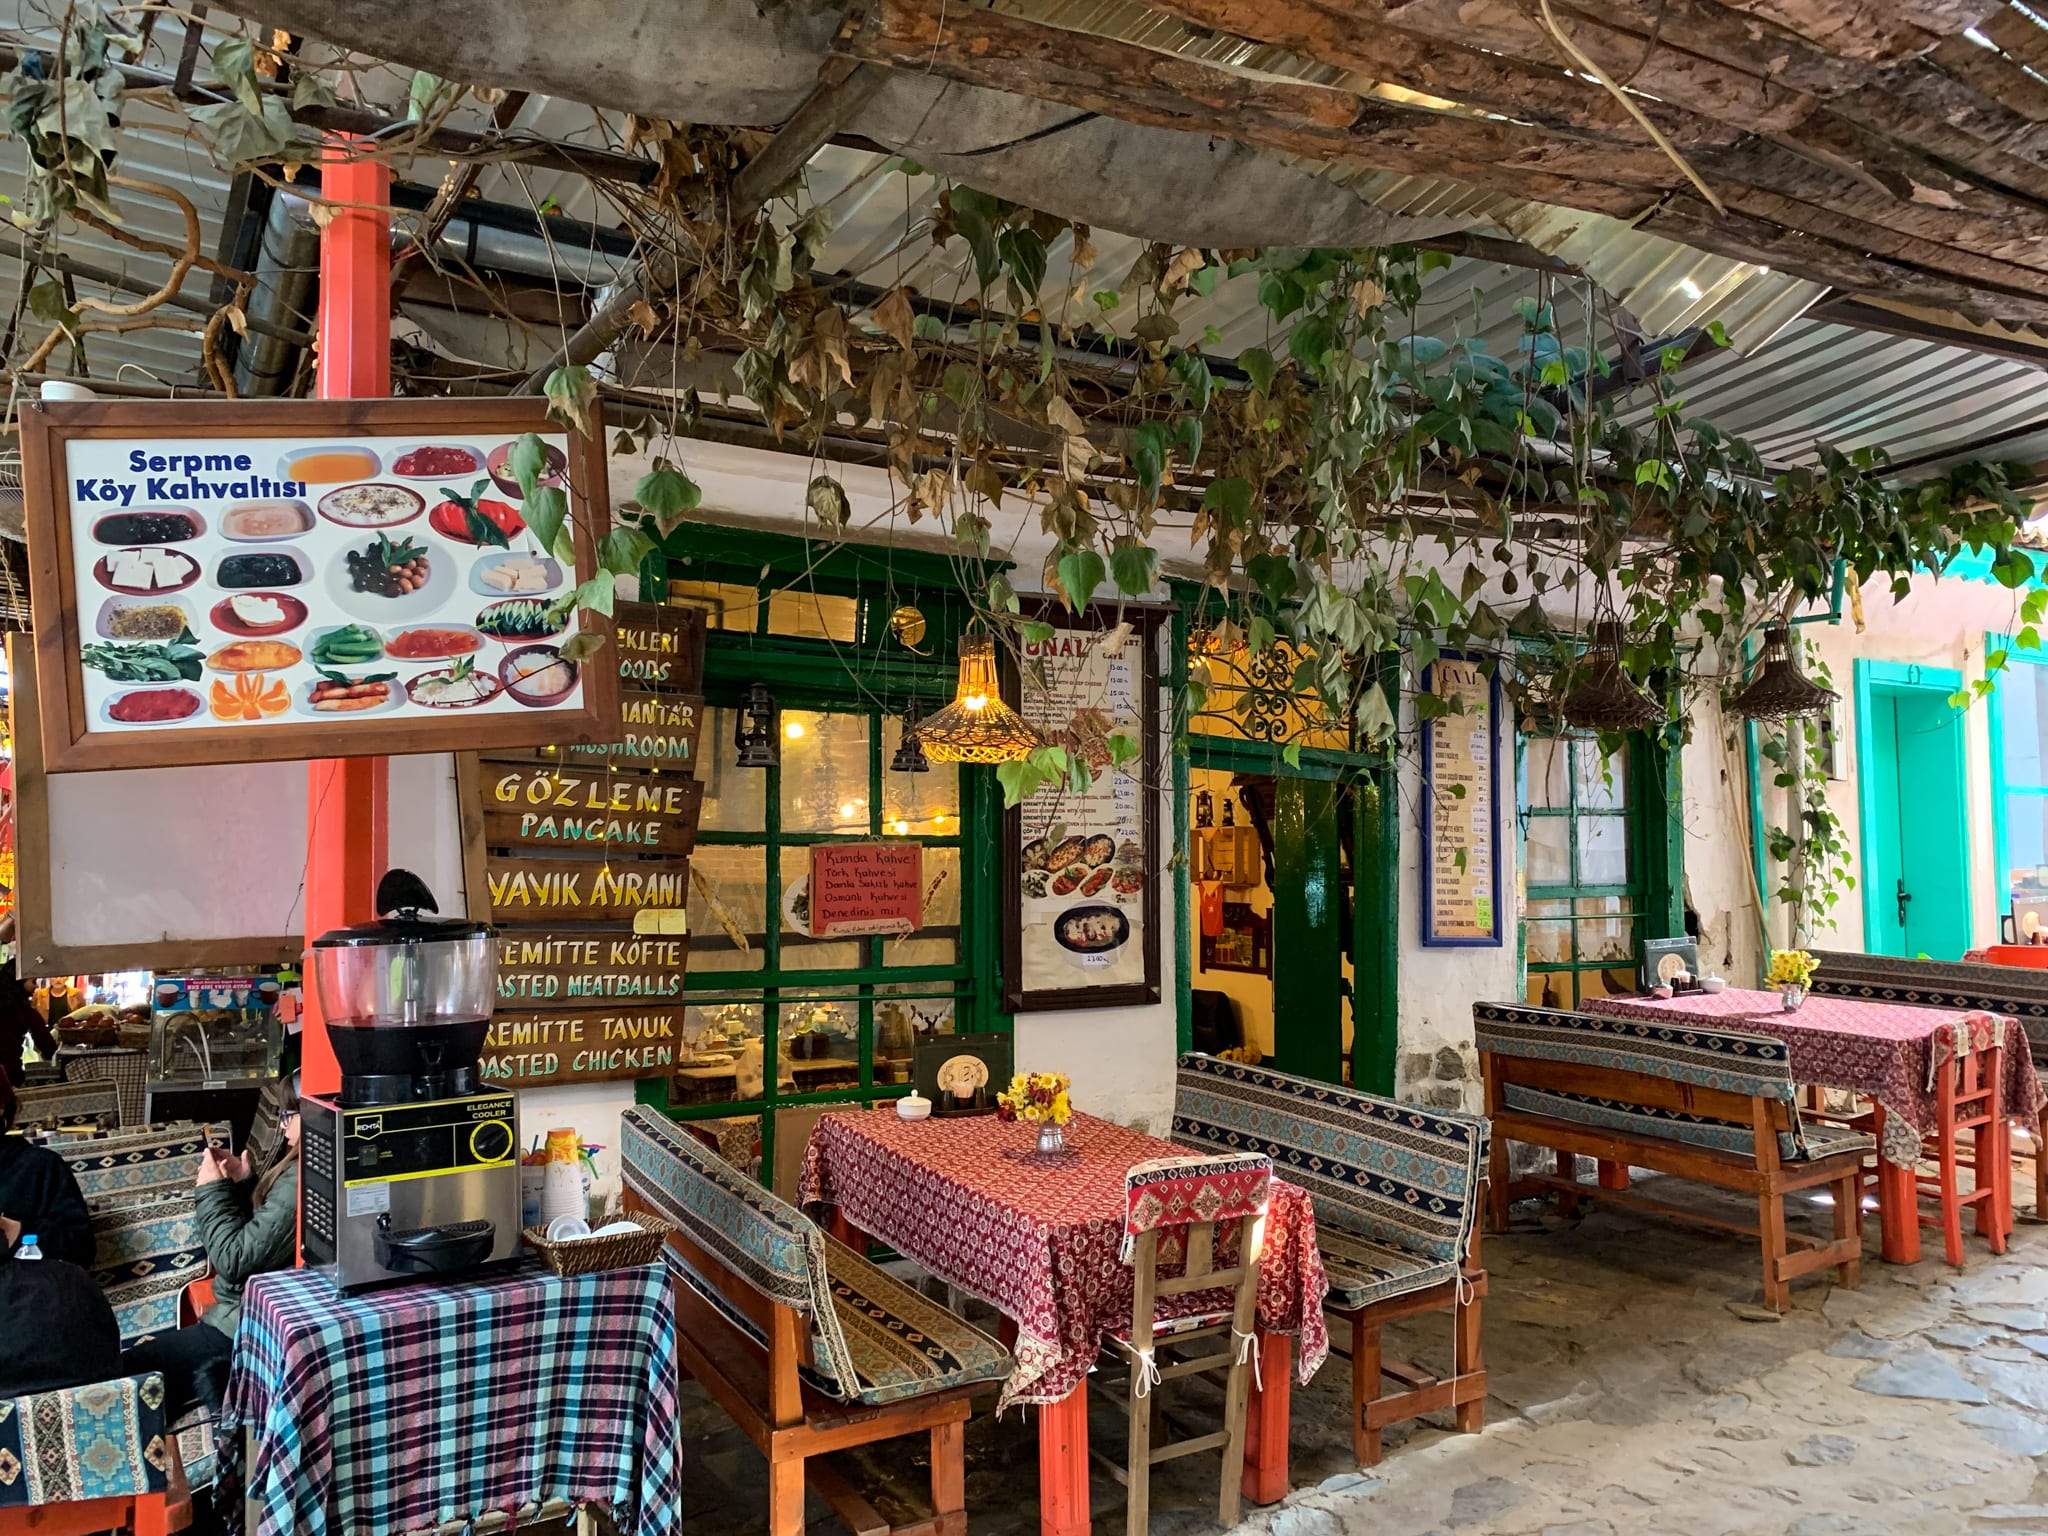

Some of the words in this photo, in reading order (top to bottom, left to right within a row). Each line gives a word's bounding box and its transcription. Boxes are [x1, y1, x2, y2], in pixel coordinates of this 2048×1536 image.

[129, 449, 252, 477] Serpme
[76, 478, 137, 507] Köy
[147, 475, 307, 500] Kahvaltısı
[495, 770, 684, 815] GÖZLEME
[521, 812, 663, 845] PANCAKE
[825, 849, 868, 866] Kumda
[487, 870, 581, 906] YAYIK
[589, 870, 682, 906] AYRANI
[610, 935, 681, 966] KÖFTE
[567, 973, 681, 997] MEATBALLS
[600, 1015, 674, 1041] TAVUK
[572, 1045, 672, 1072] CHICKEN
[466, 1100, 512, 1112] ELEGANCE
[472, 1109, 507, 1119] COOLER
